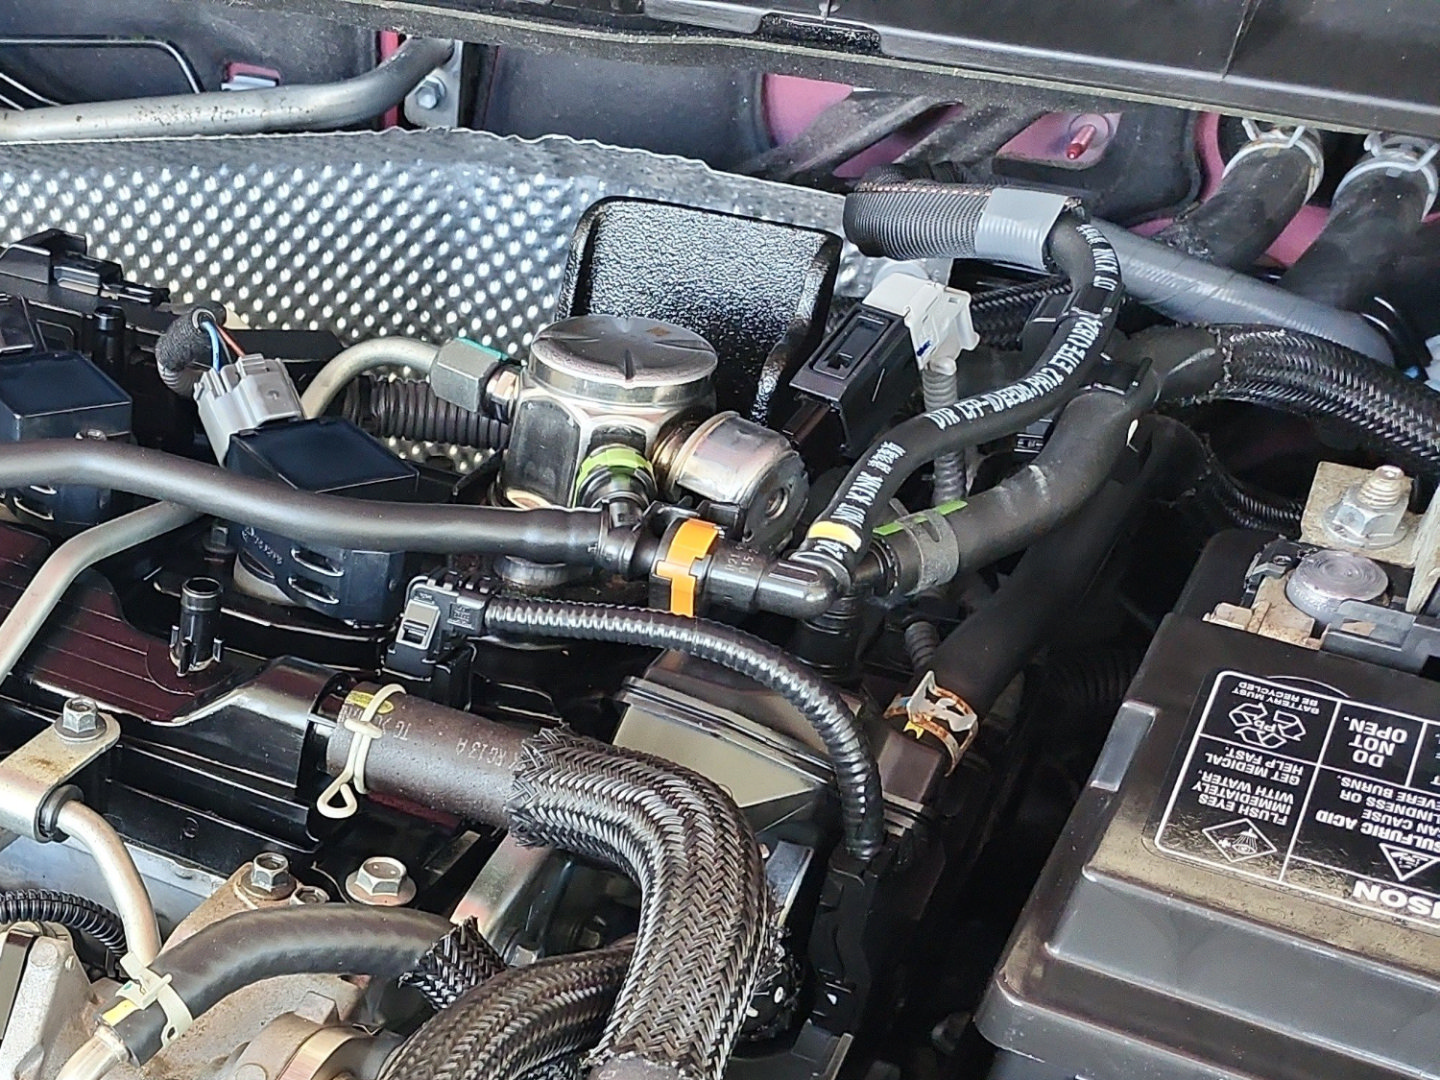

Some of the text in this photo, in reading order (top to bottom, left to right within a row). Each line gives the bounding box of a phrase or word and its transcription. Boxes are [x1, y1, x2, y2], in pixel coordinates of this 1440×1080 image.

[1344, 717, 1407, 743] OPEN.
[1349, 734, 1395, 755] NOT
[1205, 753, 1300, 785] GET MEDICAL
[1226, 747, 1303, 775] HELP FAST.
[1353, 750, 1384, 767] DO
[1192, 779, 1292, 815] IMMEDIATELY
[1199, 770, 1293, 804] WITH WATER.
[1338, 776, 1440, 811] EVERE BURNS.
[1198, 790, 1288, 826] FLUSH EYES
[1316, 810, 1357, 829] ACID
[1340, 790, 1440, 824] LINDNESS OR
[1362, 809, 1413, 829] CAUSE
